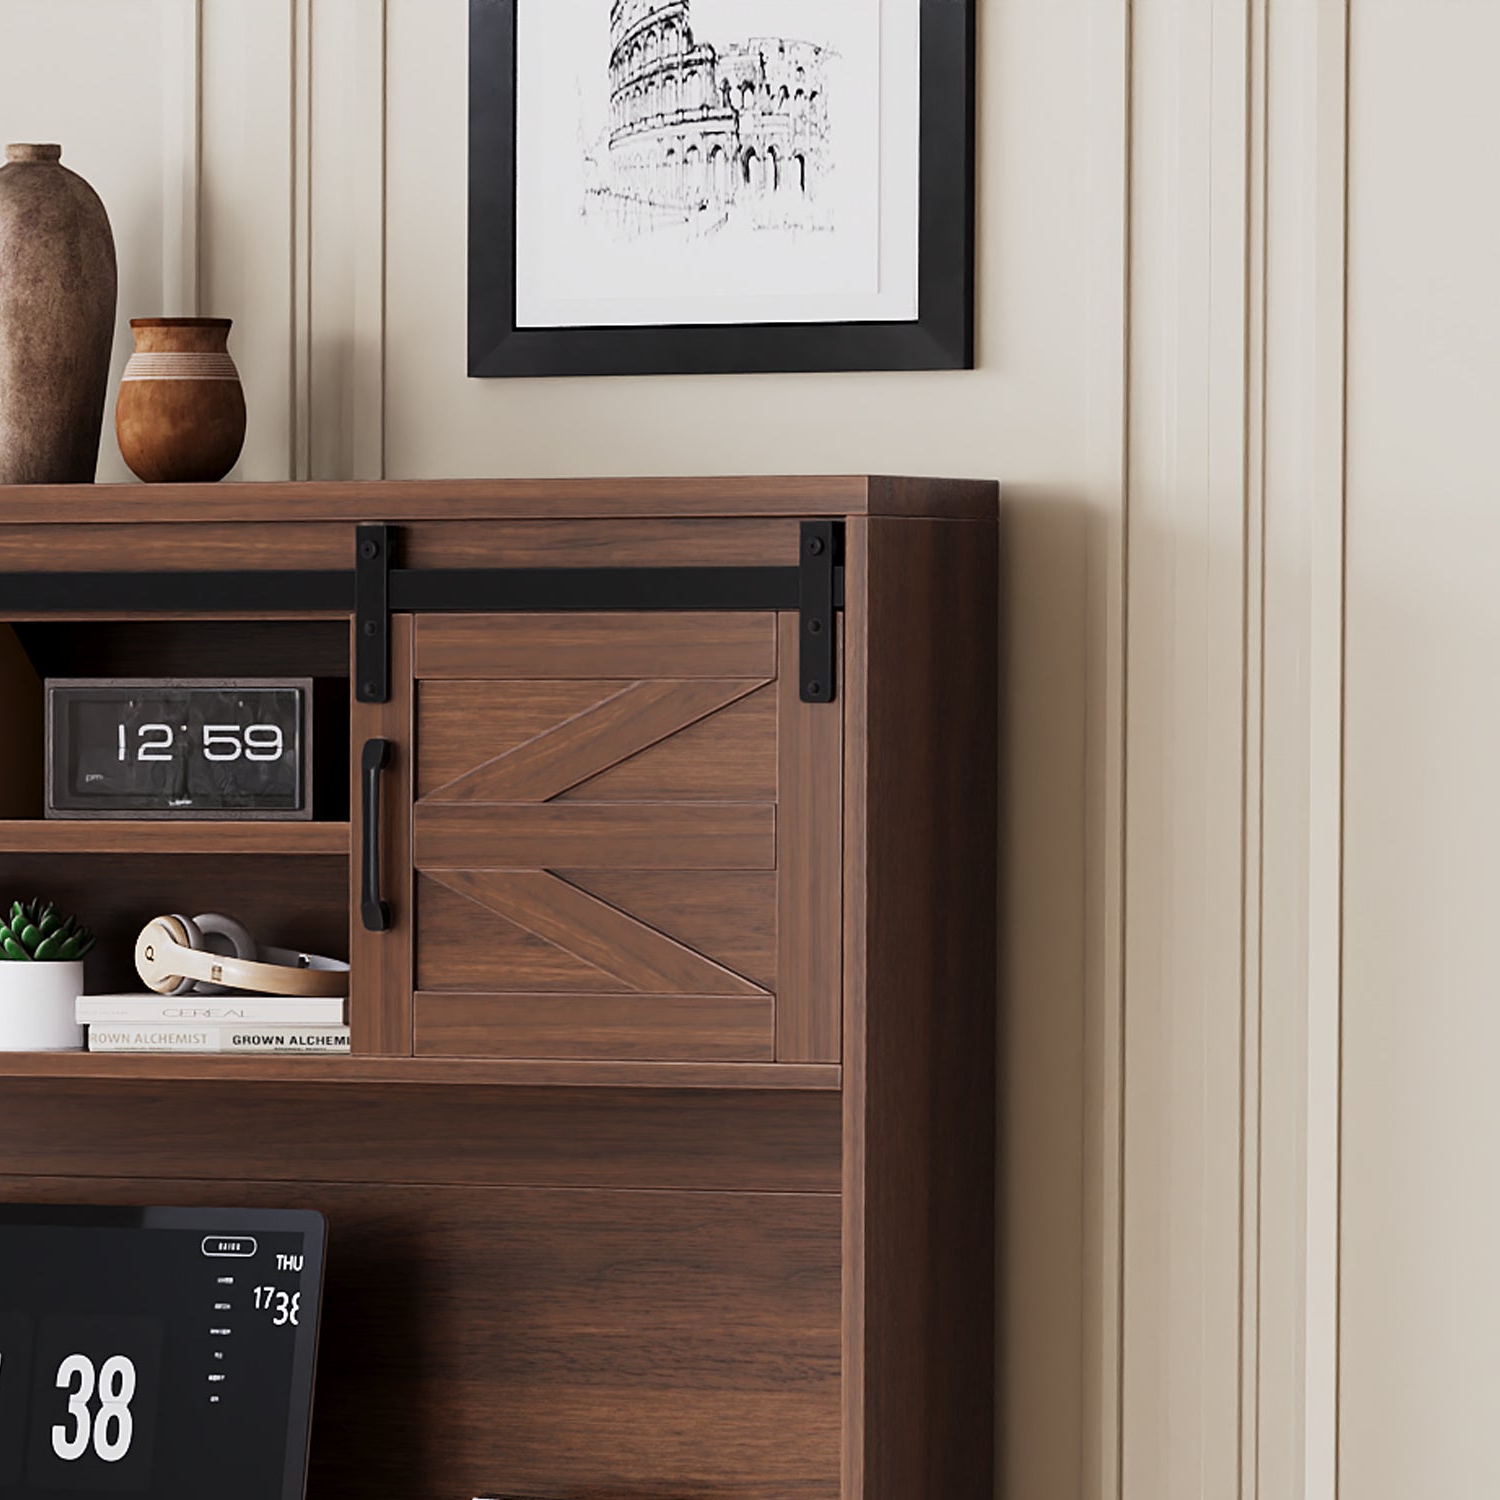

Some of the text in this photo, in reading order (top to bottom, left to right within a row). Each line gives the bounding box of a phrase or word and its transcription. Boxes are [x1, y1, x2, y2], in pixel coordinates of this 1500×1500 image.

[162, 1008, 253, 1018] CEREAL
[134, 1032, 208, 1044] ALCHEMIST
[232, 1034, 285, 1046] GROWN
[51, 1352, 137, 1462] 38
